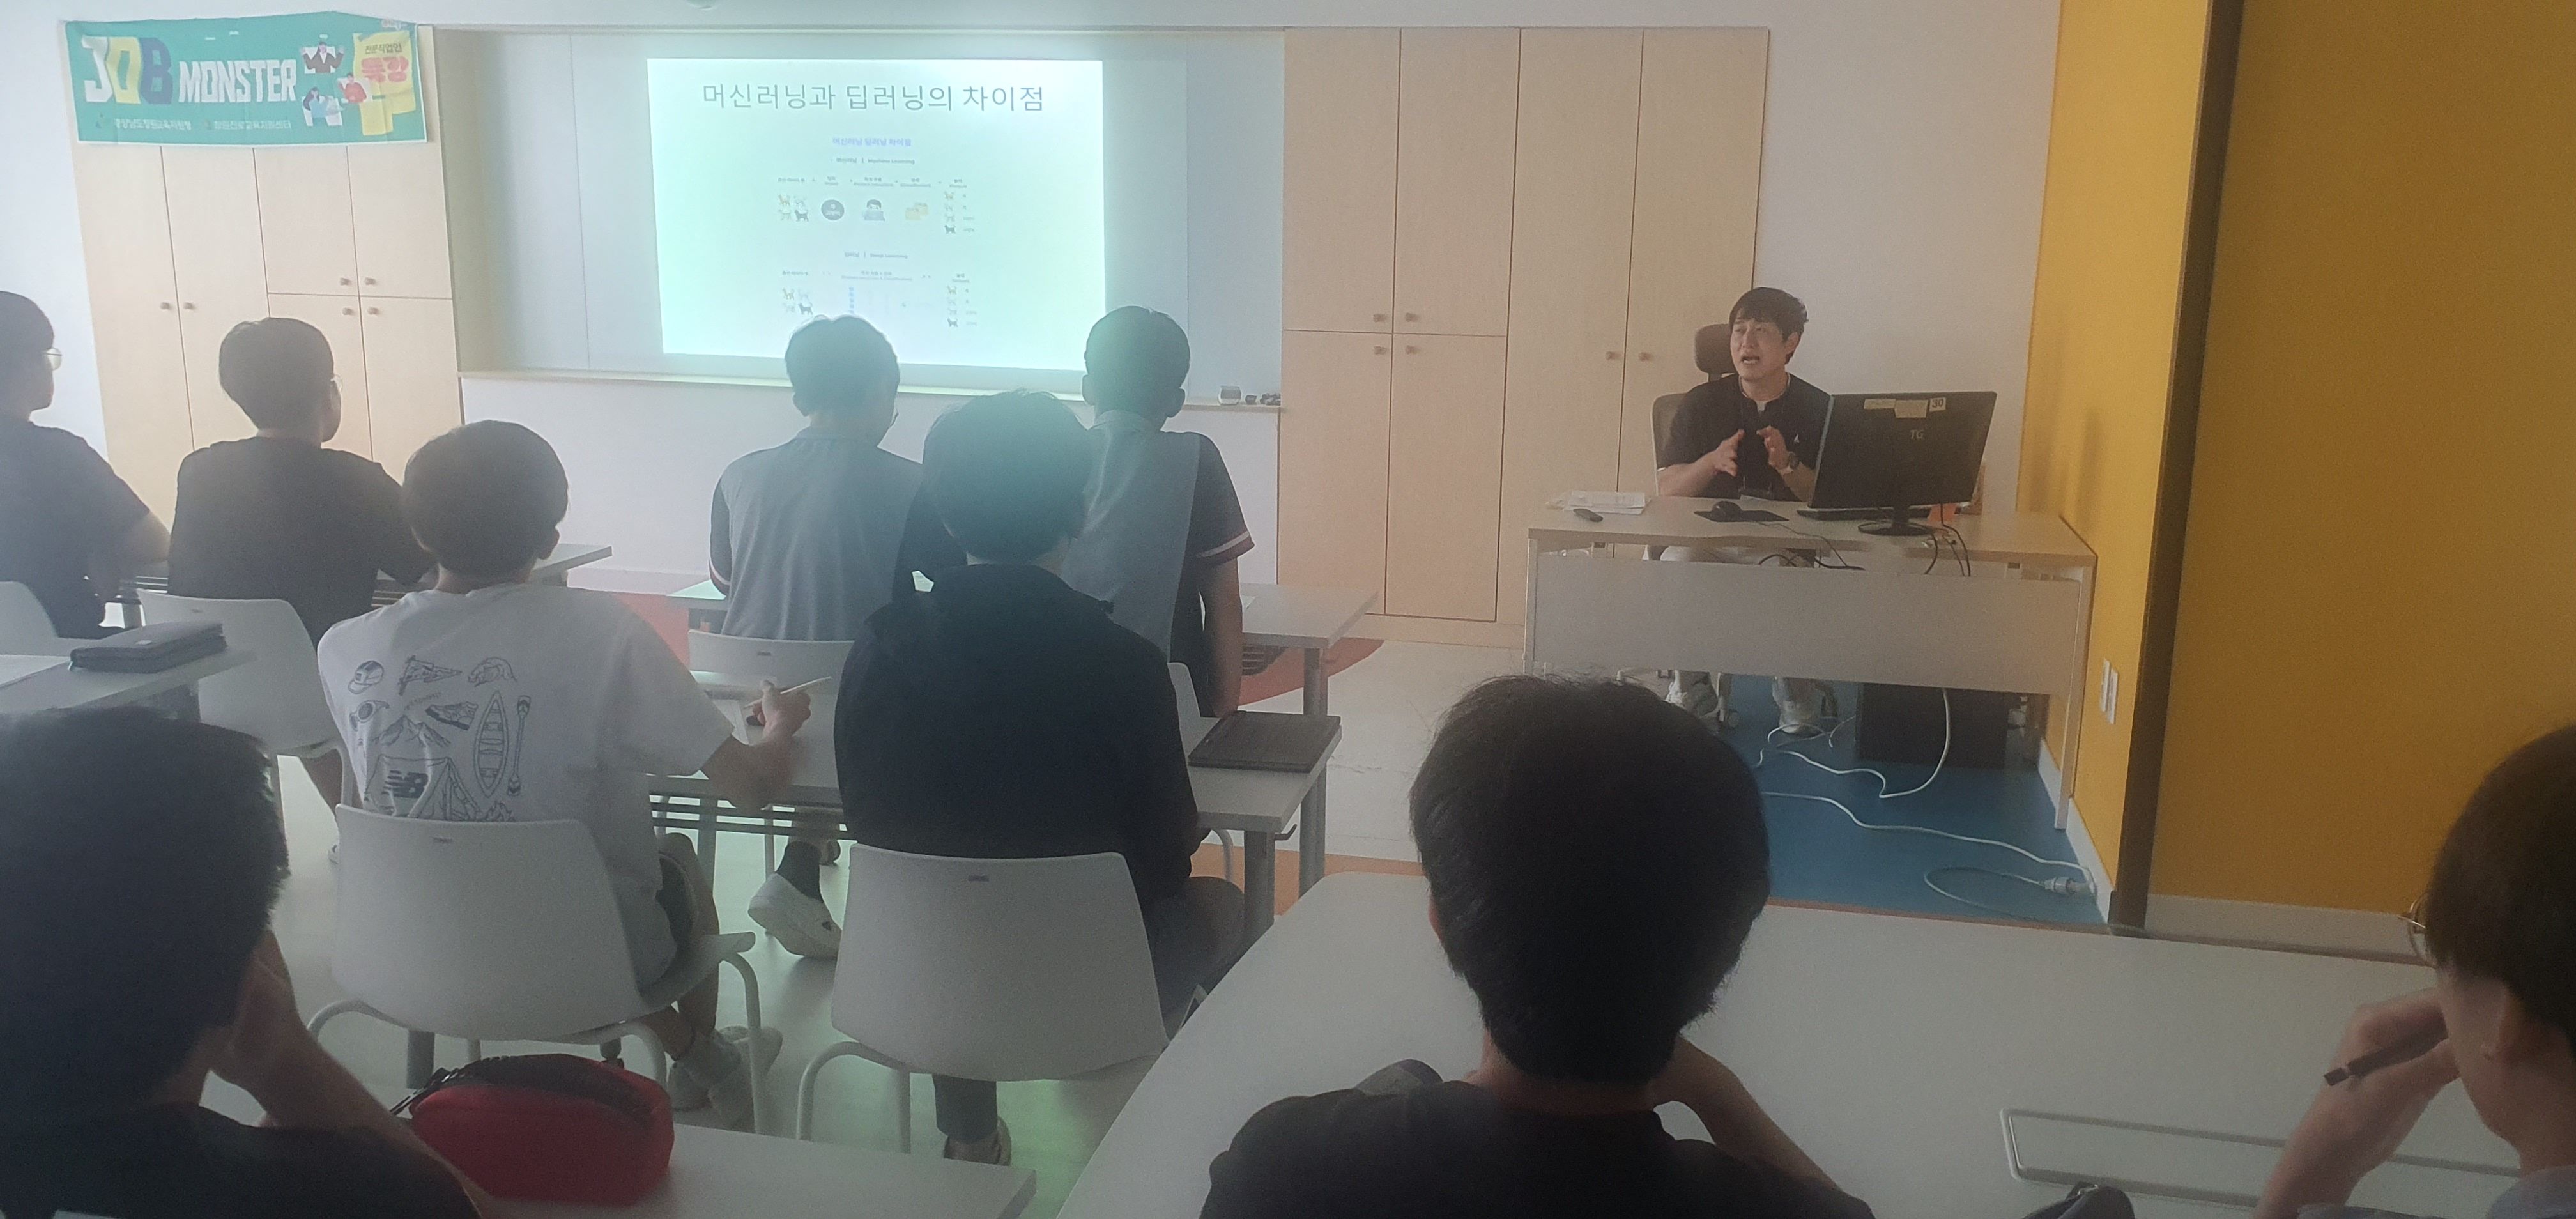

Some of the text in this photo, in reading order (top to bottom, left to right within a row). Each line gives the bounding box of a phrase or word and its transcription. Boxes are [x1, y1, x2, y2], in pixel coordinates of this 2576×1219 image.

[81, 35, 297, 104] JOB MONSTER
[702, 84, 1043, 111] 머신러닝과 딥러닝의 차이점
[1931, 398, 1943, 408] 30
[1910, 429, 1924, 440] TG
